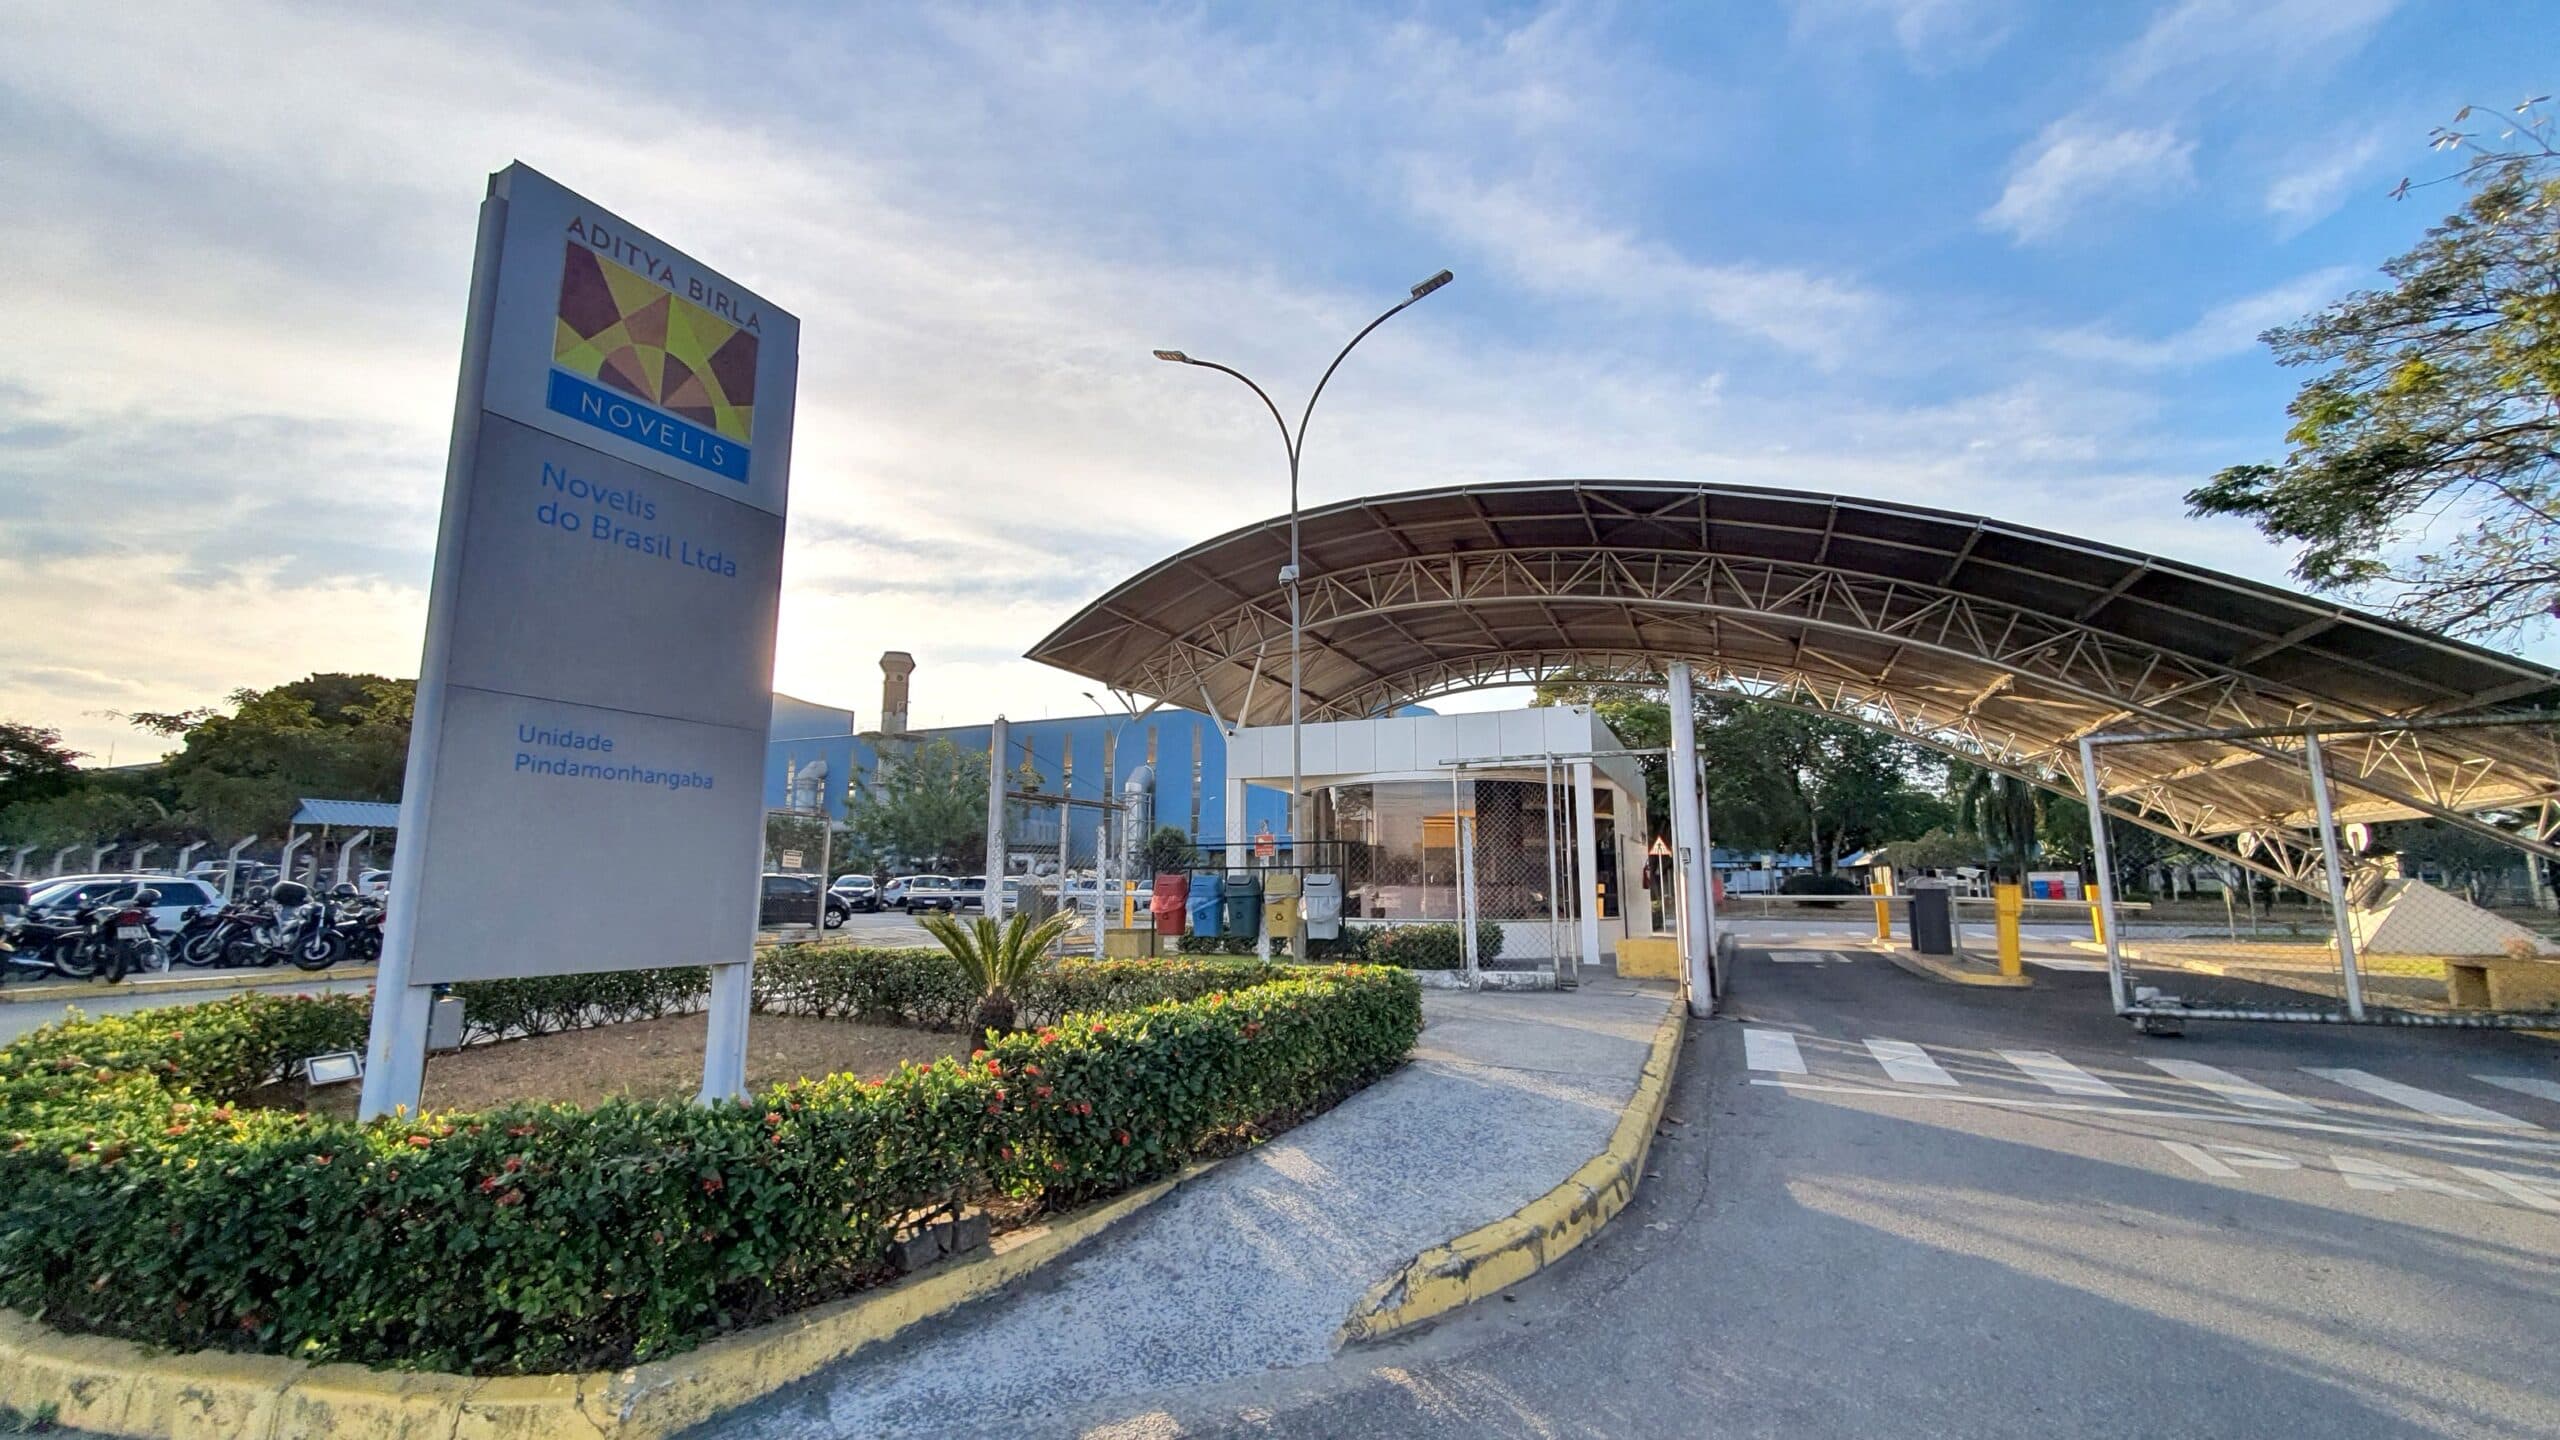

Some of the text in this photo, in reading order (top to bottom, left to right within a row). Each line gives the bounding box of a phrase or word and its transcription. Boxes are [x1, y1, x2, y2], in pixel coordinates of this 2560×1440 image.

[568, 215, 761, 333] ADITYA BIRLA
[581, 391, 724, 466] NOVELIS
[541, 463, 656, 520] Novelis
[537, 501, 737, 577] do Brasil Ltda
[518, 724, 614, 752] Unidade
[515, 753, 714, 790] Pindamonhangaba
